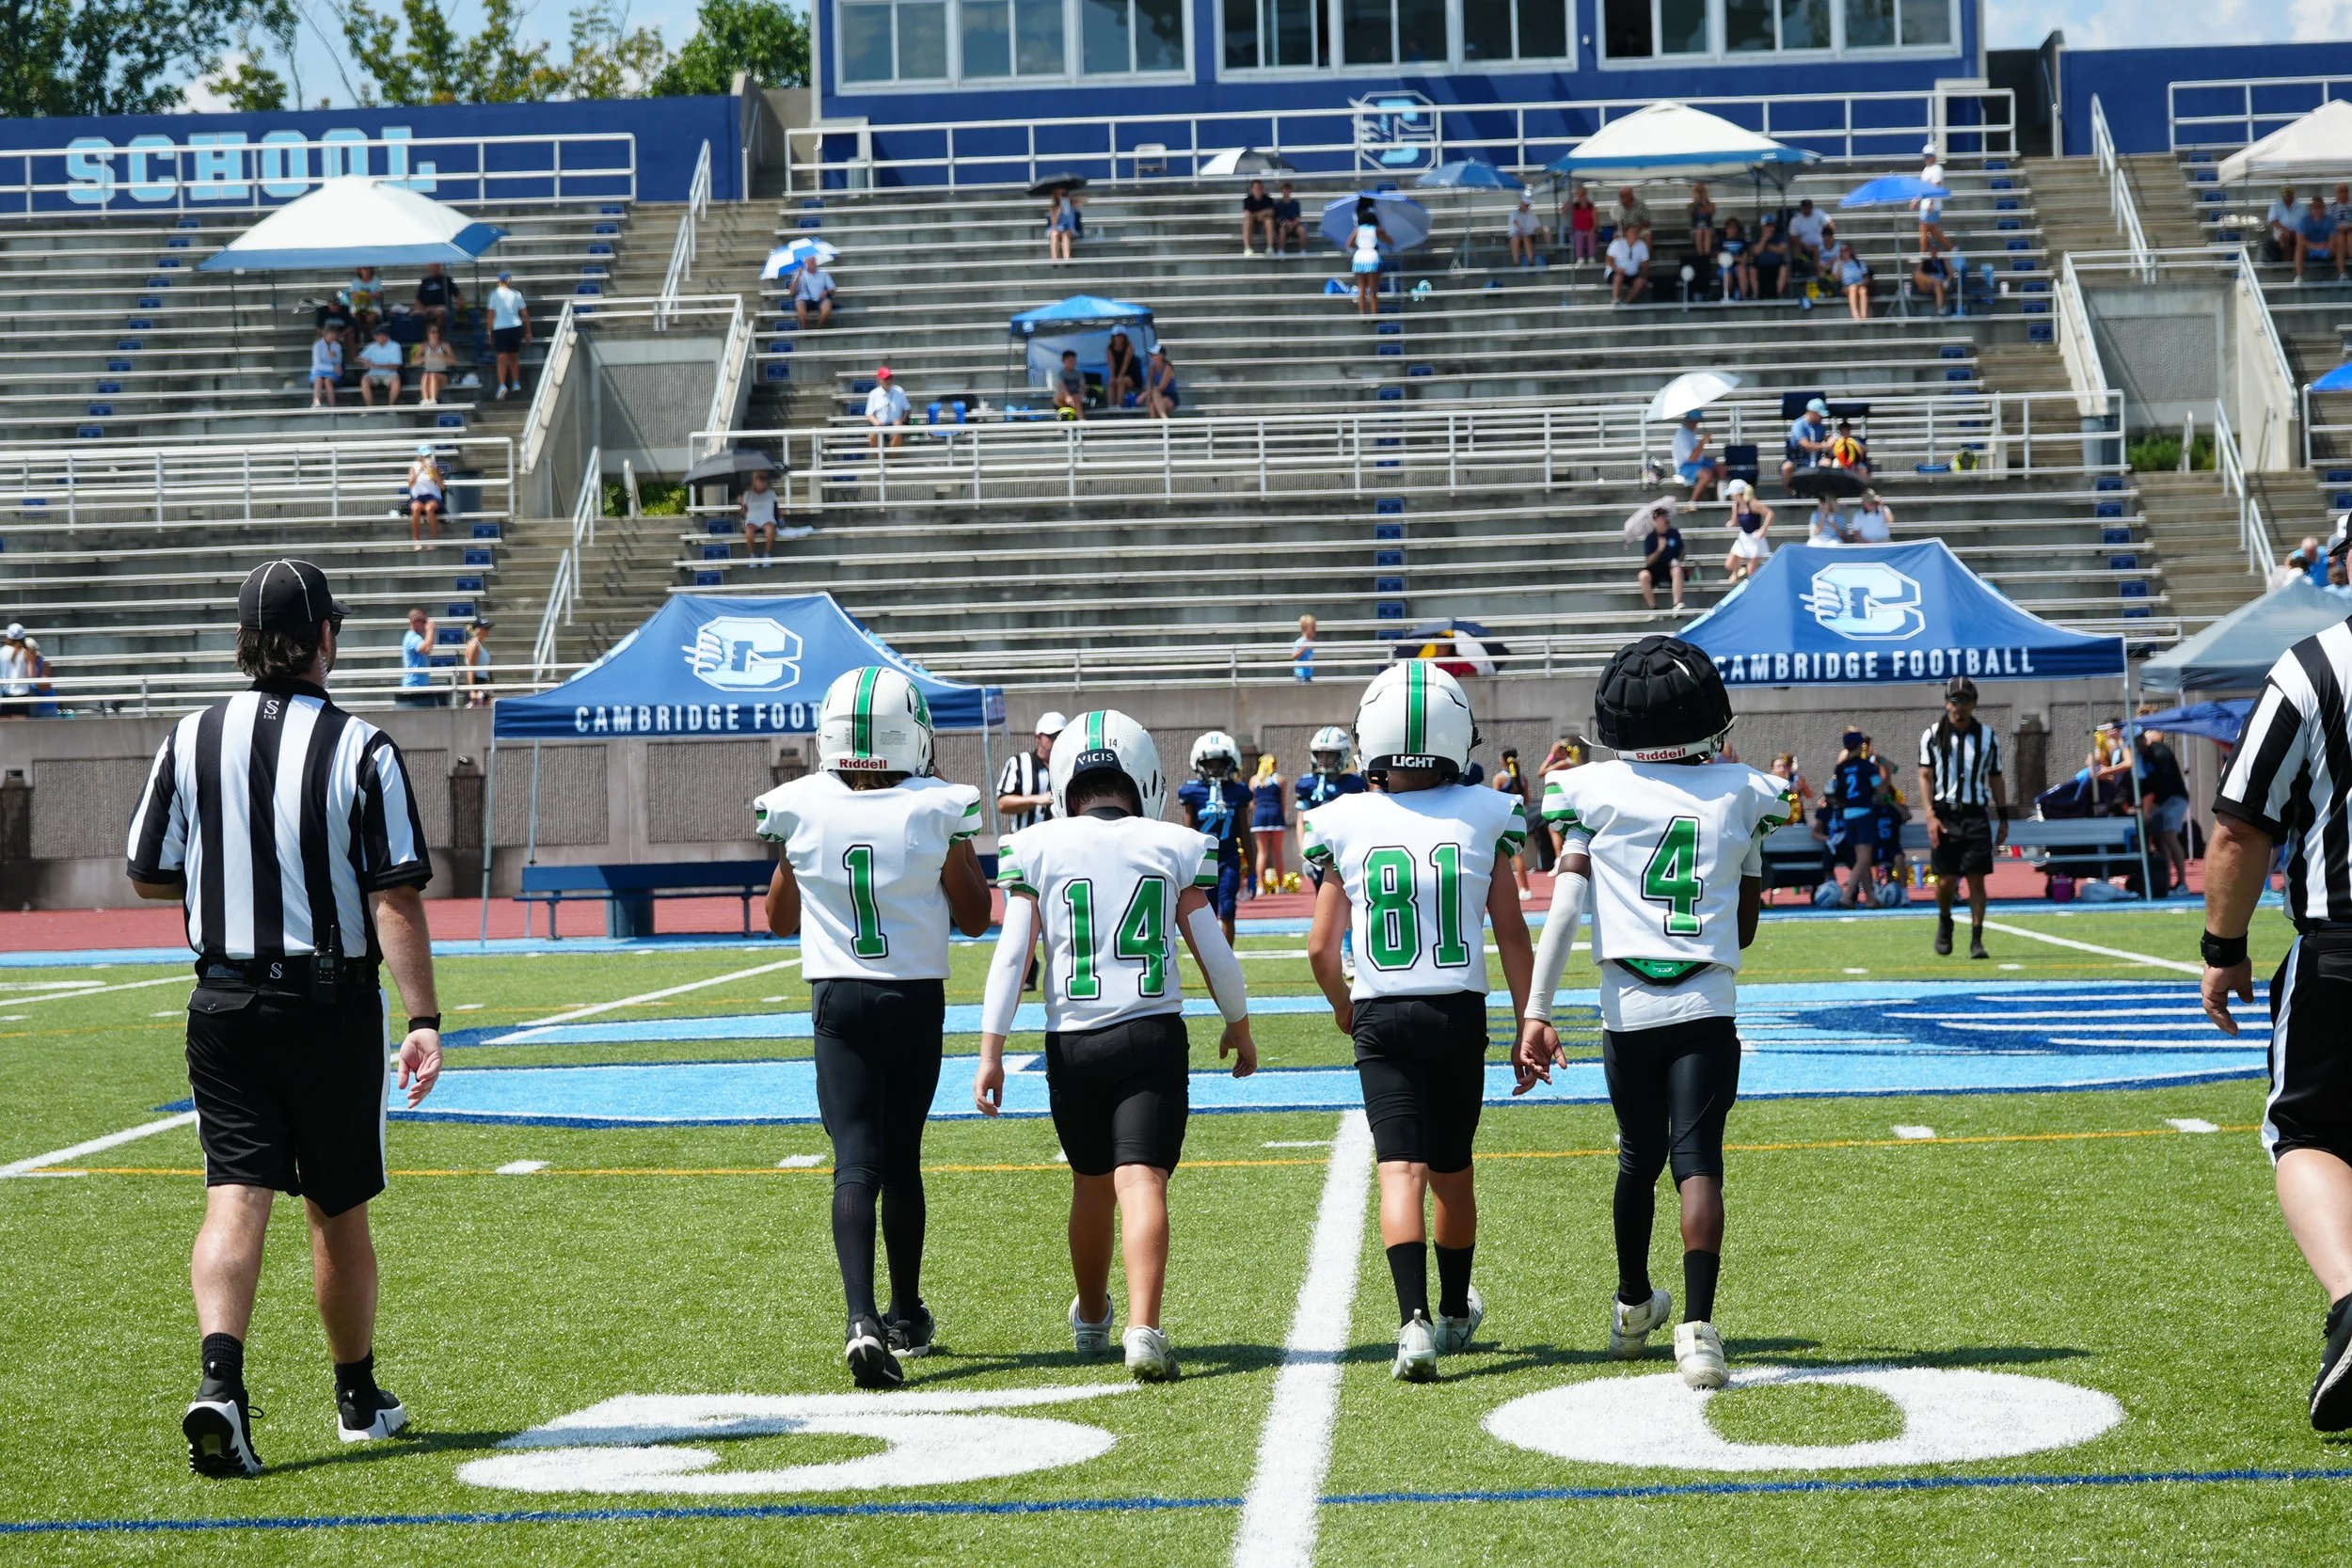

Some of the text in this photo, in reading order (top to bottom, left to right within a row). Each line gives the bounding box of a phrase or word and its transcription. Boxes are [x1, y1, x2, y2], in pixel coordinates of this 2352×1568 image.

[66, 126, 437, 204] SCHOOL
[1800, 562, 1925, 641] C
[681, 616, 803, 692] C
[1712, 646, 2035, 682] CAMBRIDGE FOOTBALL
[574, 702, 818, 733] CAMBRIDGE FOOT
[1077, 752, 1114, 765] VICIS
[1108, 738, 1118, 747] 14
[1636, 747, 1686, 761] Riddell
[839, 758, 887, 769] Riddell
[1392, 755, 1436, 768] LIGHT
[1846, 773, 1860, 800] 2
[1641, 816, 1703, 937] 4
[843, 844, 888, 959] 1
[1362, 842, 1470, 971] 81
[1062, 875, 1169, 1001] 14
